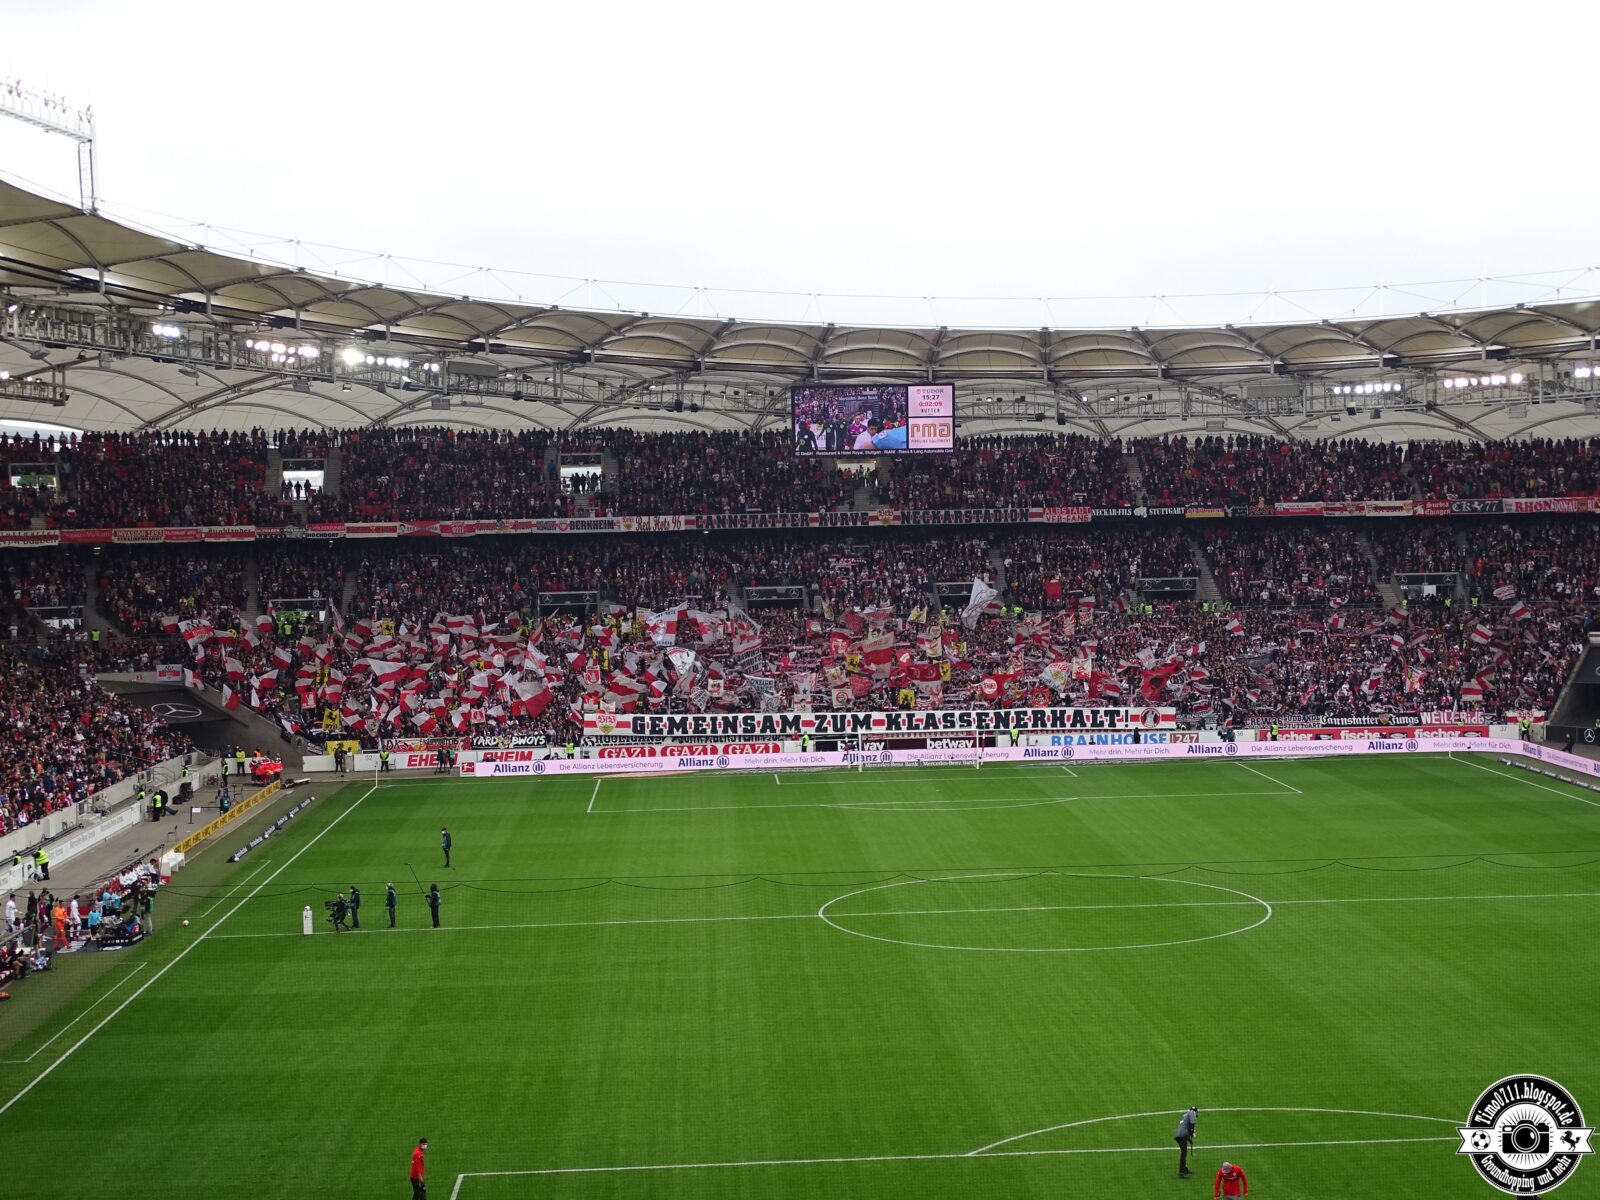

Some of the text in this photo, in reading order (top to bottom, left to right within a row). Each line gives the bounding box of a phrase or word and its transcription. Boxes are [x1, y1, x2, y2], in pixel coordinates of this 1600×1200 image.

[1044, 506, 1091, 515] ALBSTADT
[1091, 508, 1132, 517] NECKAR-FILS
[1148, 507, 1186, 516] STUTTGART
[671, 514, 682, 530] 96
[695, 511, 869, 530] CANNSTATTER KURVE
[900, 508, 1030, 525] NECKARSTADION
[569, 519, 614, 530] BERKHEIM
[631, 708, 1130, 735] GEMEINSAM ZUM KLASSENERHALT!
[1320, 713, 1420, 727] Cannstatter Jungs
[1175, 733, 1198, 744] 247
[1266, 731, 1313, 741] fscher
[1413, 729, 1461, 739] fischer
[472, 736, 498, 746] YARD
[512, 735, 546, 746] BWOYS
[926, 737, 974, 750] betway
[1367, 741, 1403, 751] Allianz
[604, 744, 775, 759] GAZI GAZI GAZI
[1023, 746, 1059, 758] Allianz
[1186, 744, 1223, 755] Allianz
[1263, 744, 1286, 752] Allianz
[1287, 743, 1353, 753] Lebensversicherung
[920, 752, 943, 760] Allianz
[493, 763, 530, 773] Allianz
[560, 760, 664, 771] Die Allianz Lebensversicherung
[678, 757, 715, 768] Allianz
